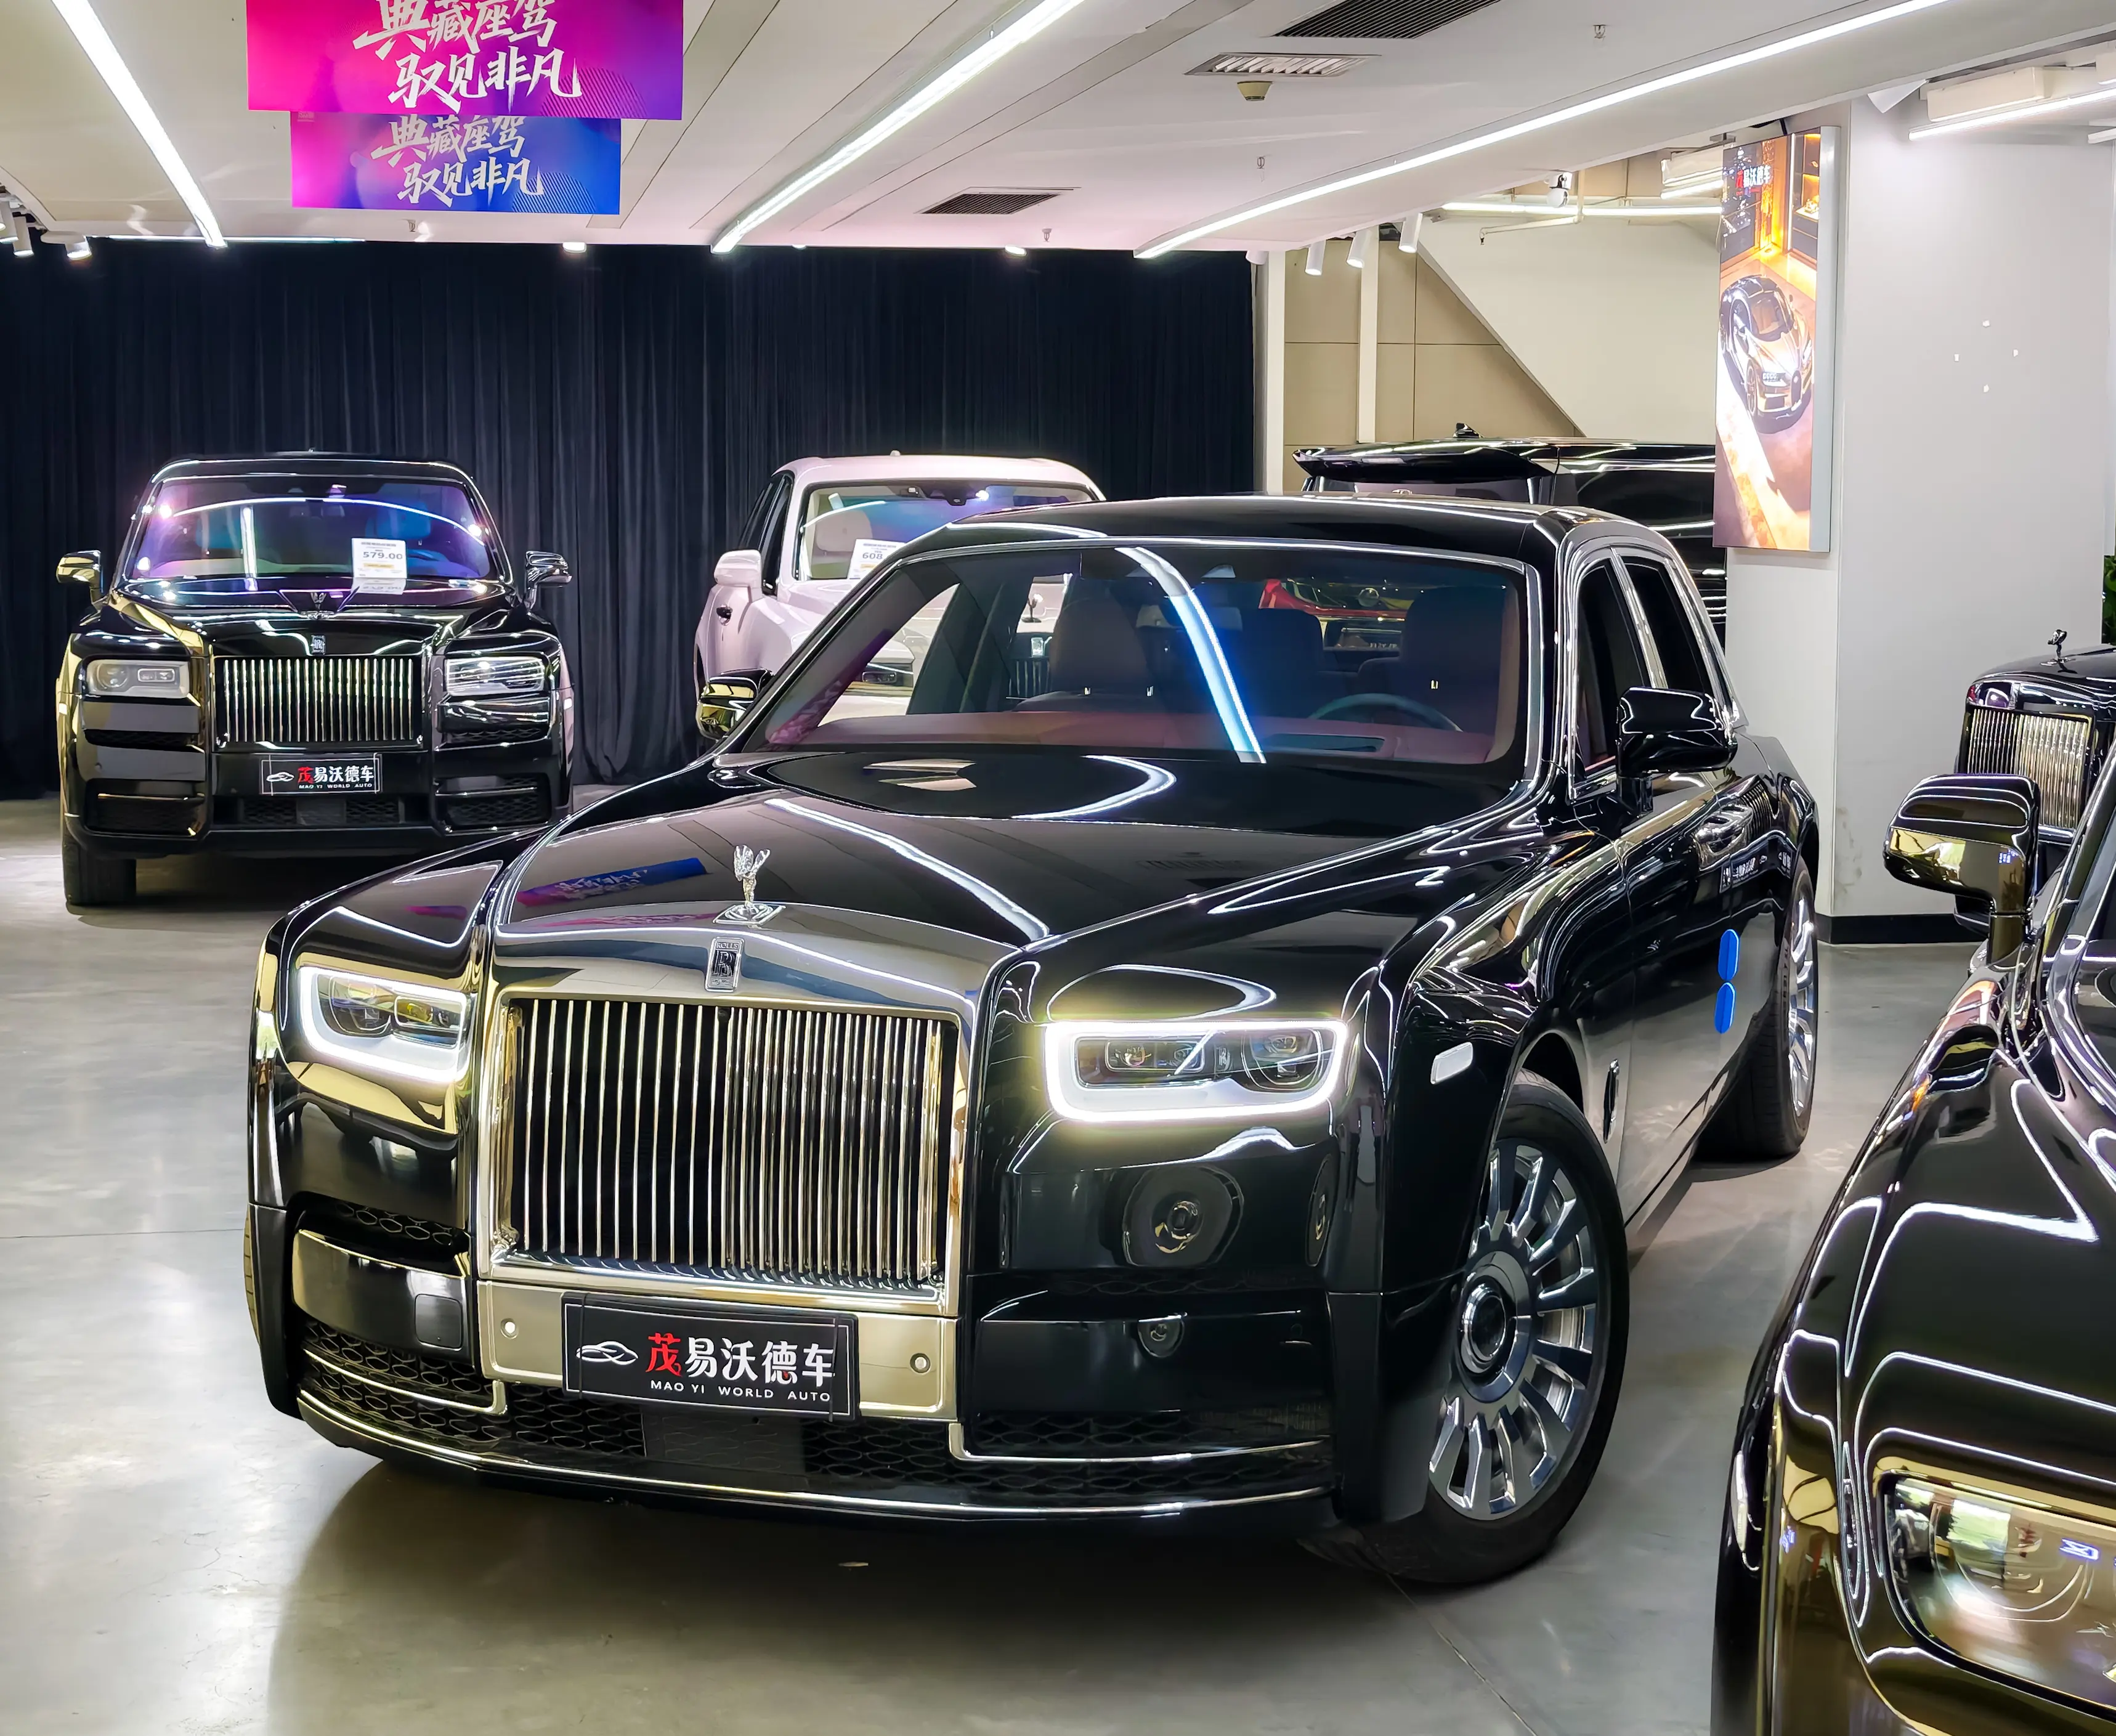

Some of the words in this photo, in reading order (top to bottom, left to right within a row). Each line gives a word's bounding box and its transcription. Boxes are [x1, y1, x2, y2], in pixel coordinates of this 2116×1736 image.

[353, 0, 557, 60] 典藏座驾
[388, 46, 582, 113] 驭见非凡
[370, 115, 525, 167] 典藏座驾
[397, 156, 544, 207] 驭见非凡
[363, 551, 403, 560] 579.00
[298, 765, 374, 784] 茂易沃德车
[645, 1332, 835, 1387] 茂易沃德车
[651, 1379, 684, 1392] MAO
[691, 1384, 705, 1394] YI
[718, 1386, 774, 1398] WORLD
[787, 1390, 831, 1402] AUTO
